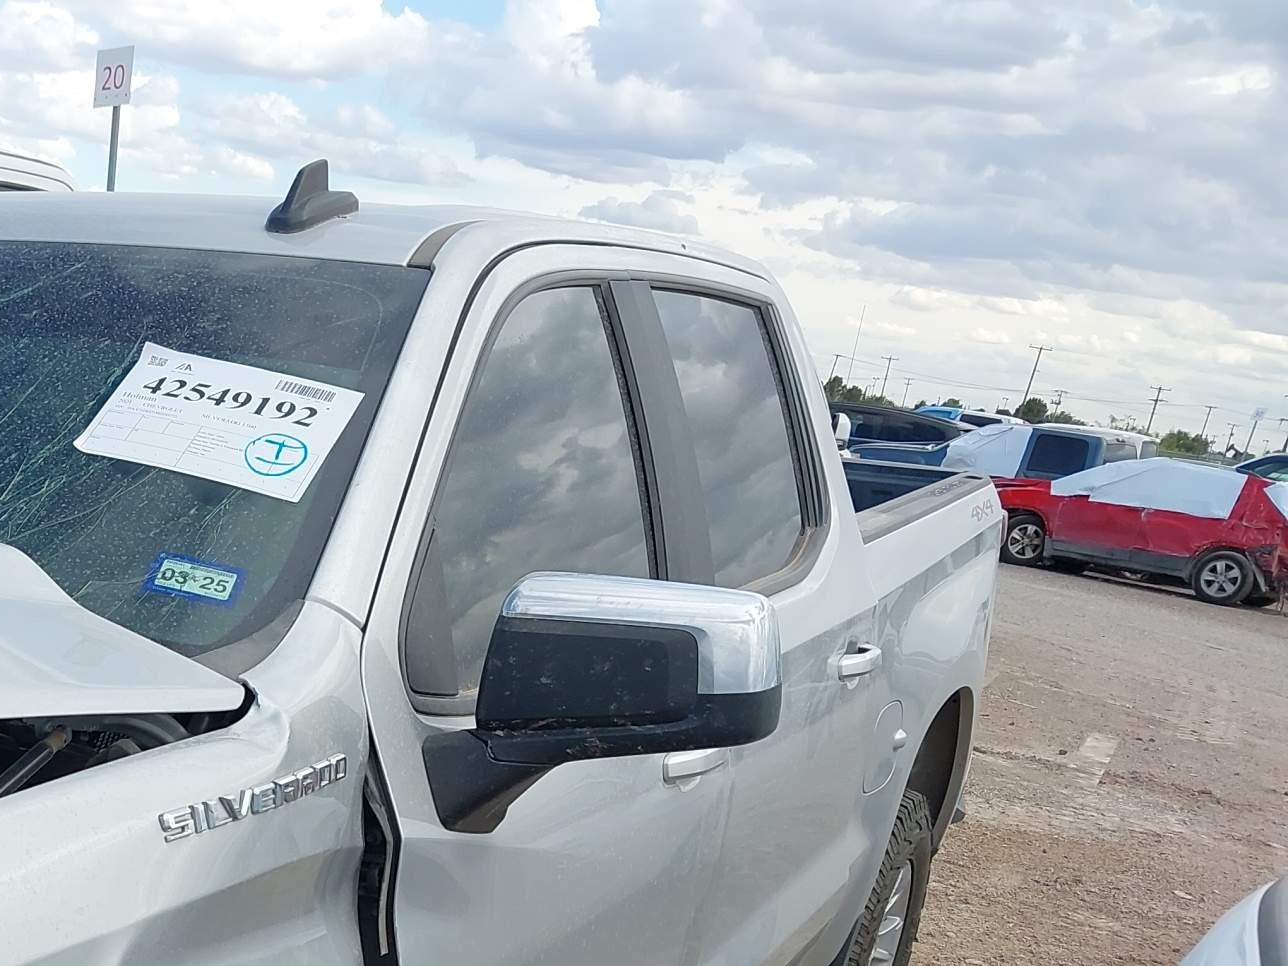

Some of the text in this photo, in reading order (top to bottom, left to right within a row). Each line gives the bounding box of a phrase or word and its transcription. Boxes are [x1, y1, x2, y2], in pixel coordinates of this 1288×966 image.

[101, 63, 125, 91] 20
[143, 376, 318, 428] 42549192
[161, 568, 189, 585] 03
[199, 576, 229, 593] 25
[158, 752, 348, 843] SILVERADO
